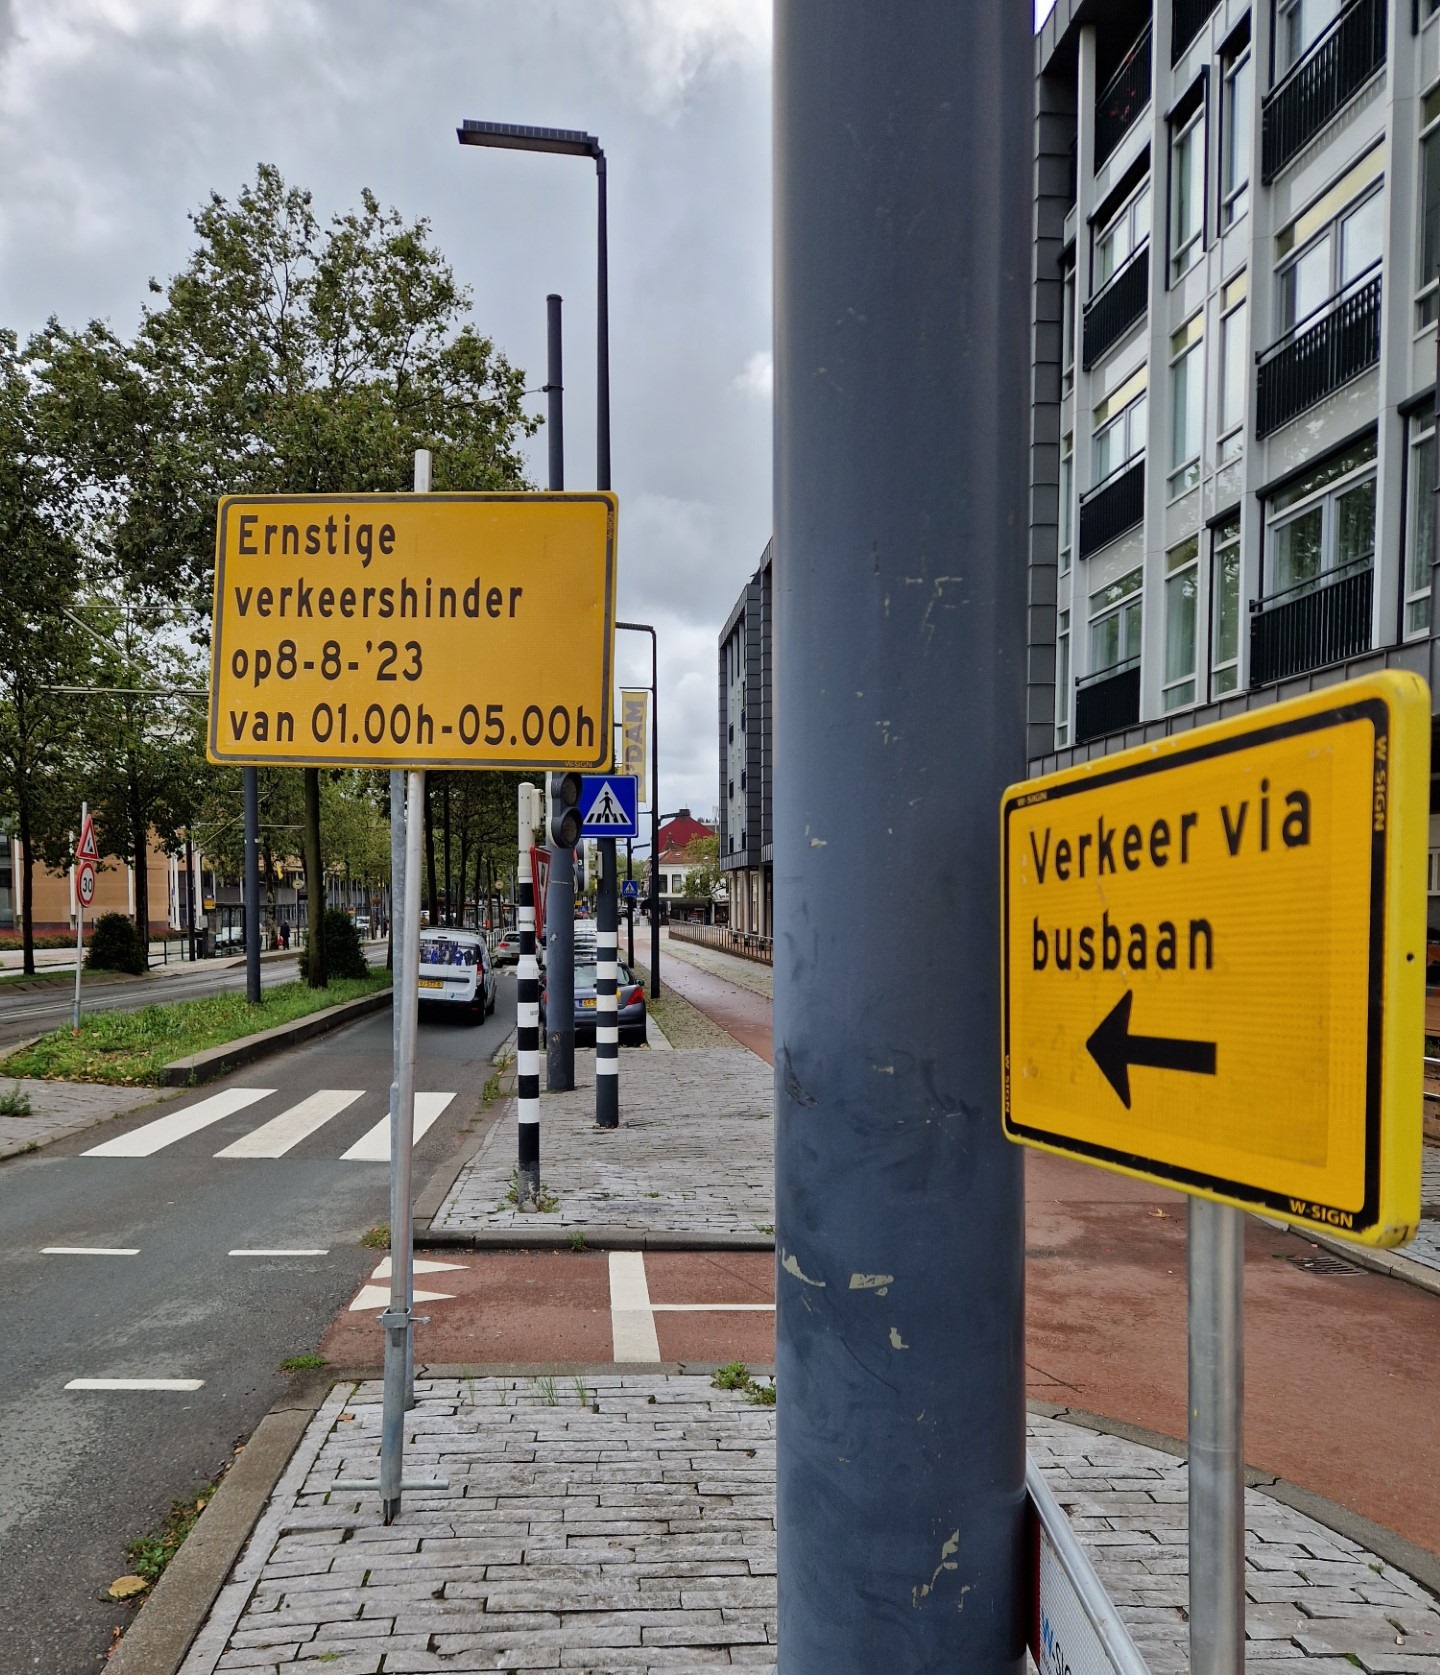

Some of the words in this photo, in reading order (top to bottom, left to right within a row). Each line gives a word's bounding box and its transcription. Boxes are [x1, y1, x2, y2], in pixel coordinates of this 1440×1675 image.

[238, 513, 396, 568] Ernstige
[234, 576, 523, 619] verkeershinder
[229, 710, 294, 742] van
[311, 702, 595, 747] 01.00h-05.00h
[1372, 734, 1388, 833] W-SIGN
[1030, 810, 1198, 885] Verkeer
[1220, 778, 1311, 857] via
[82, 876, 93, 893] 30
[1032, 910, 1214, 972] busbaan
[1289, 1198, 1354, 1228] W-SIGN
